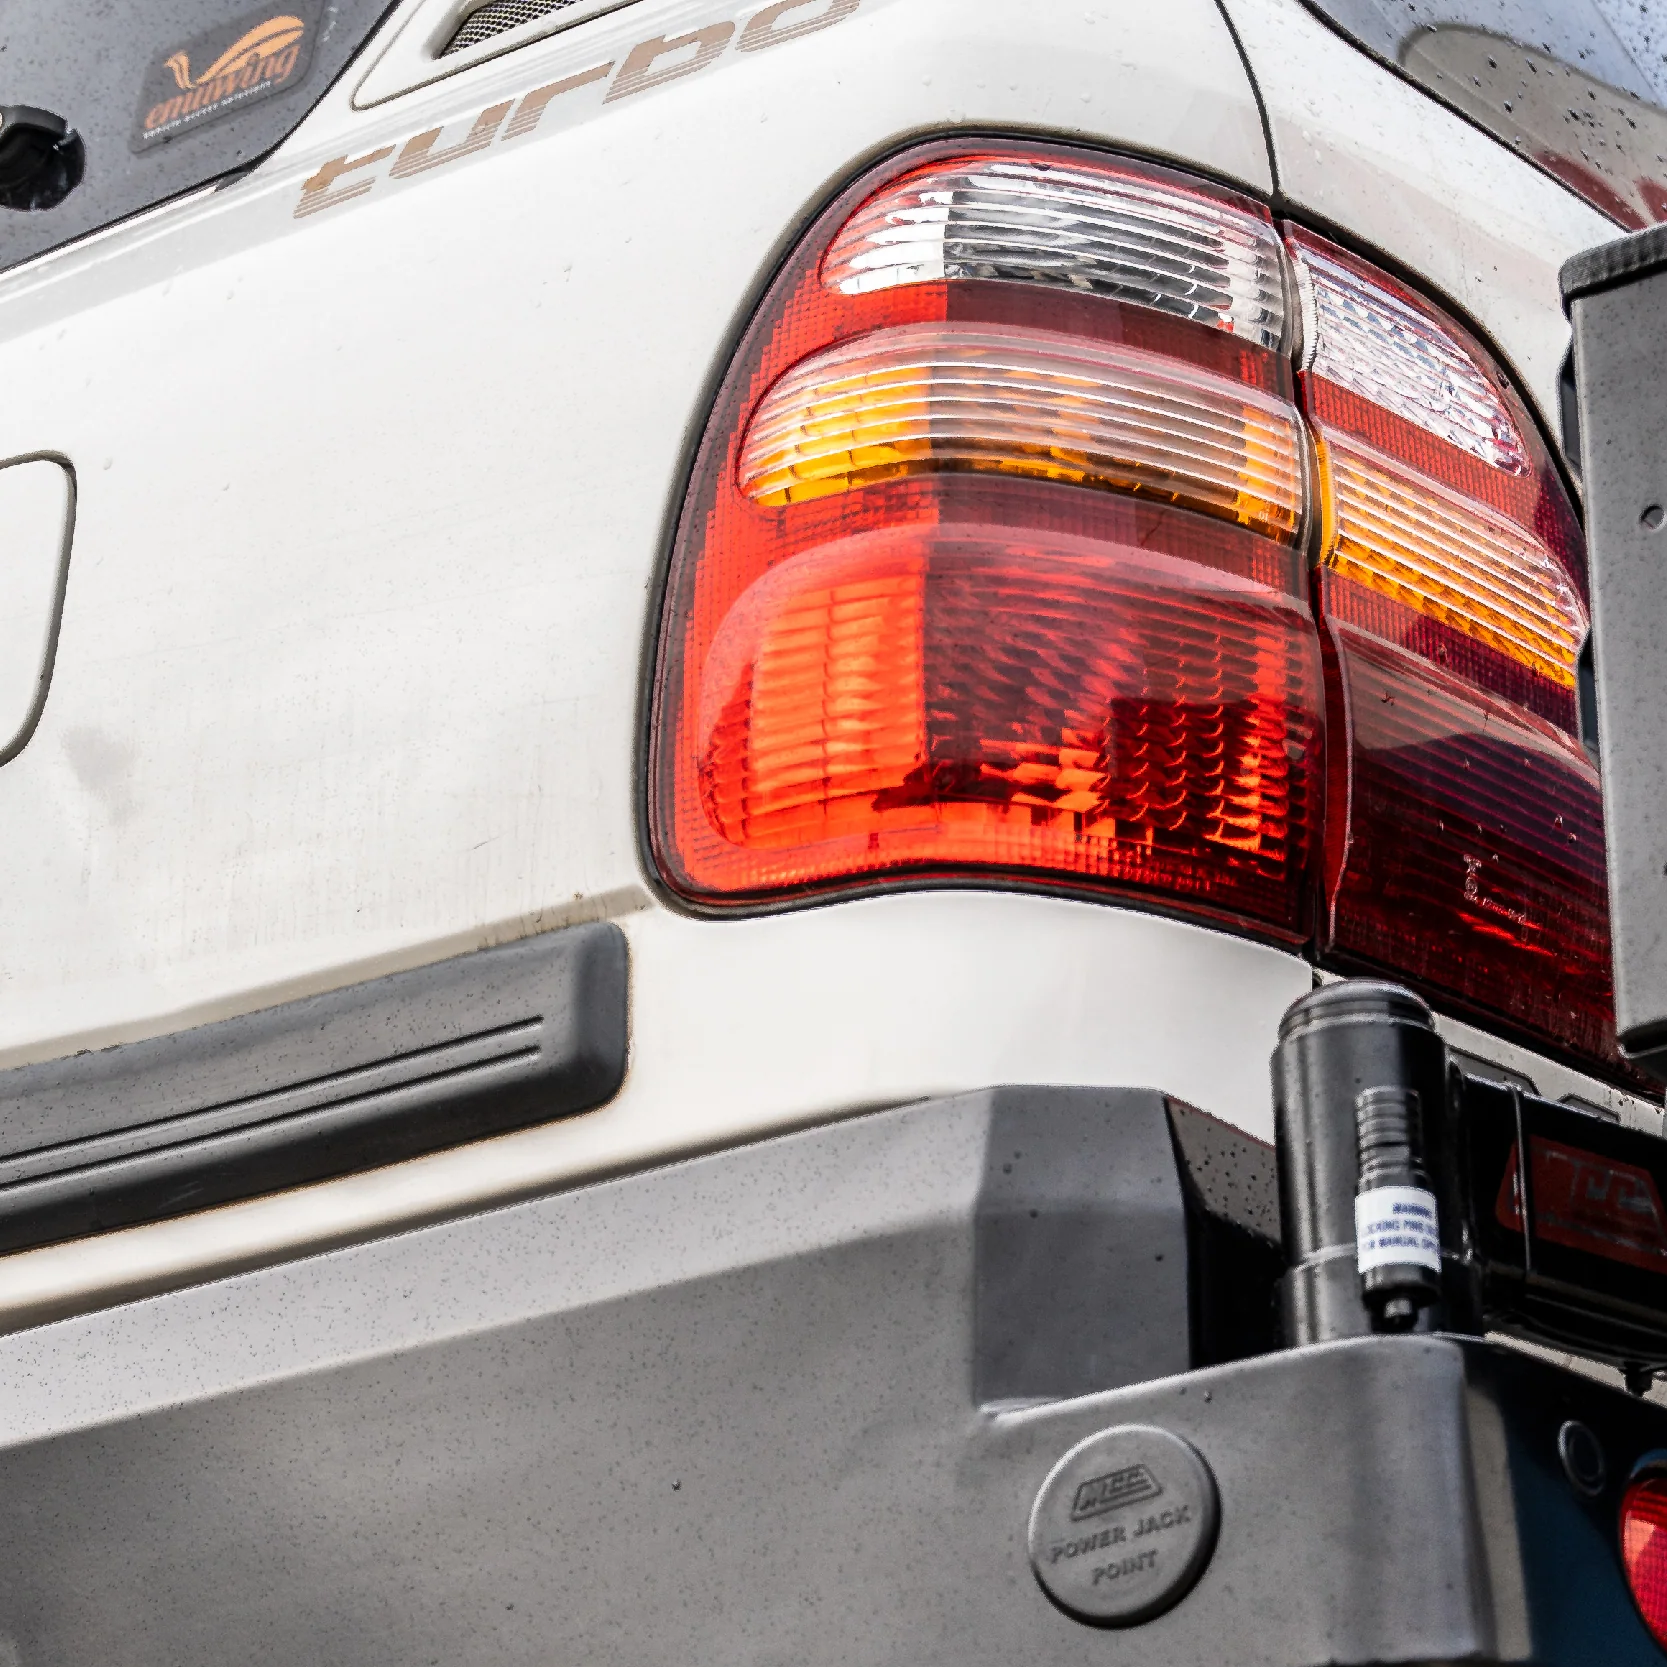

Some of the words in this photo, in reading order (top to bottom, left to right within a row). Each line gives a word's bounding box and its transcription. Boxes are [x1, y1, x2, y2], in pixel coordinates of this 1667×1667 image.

[293, 0, 860, 218] turbo
[1050, 1526, 1127, 1565] POWER
[1132, 1504, 1192, 1538] JACK
[1091, 1549, 1158, 1586] POINT
